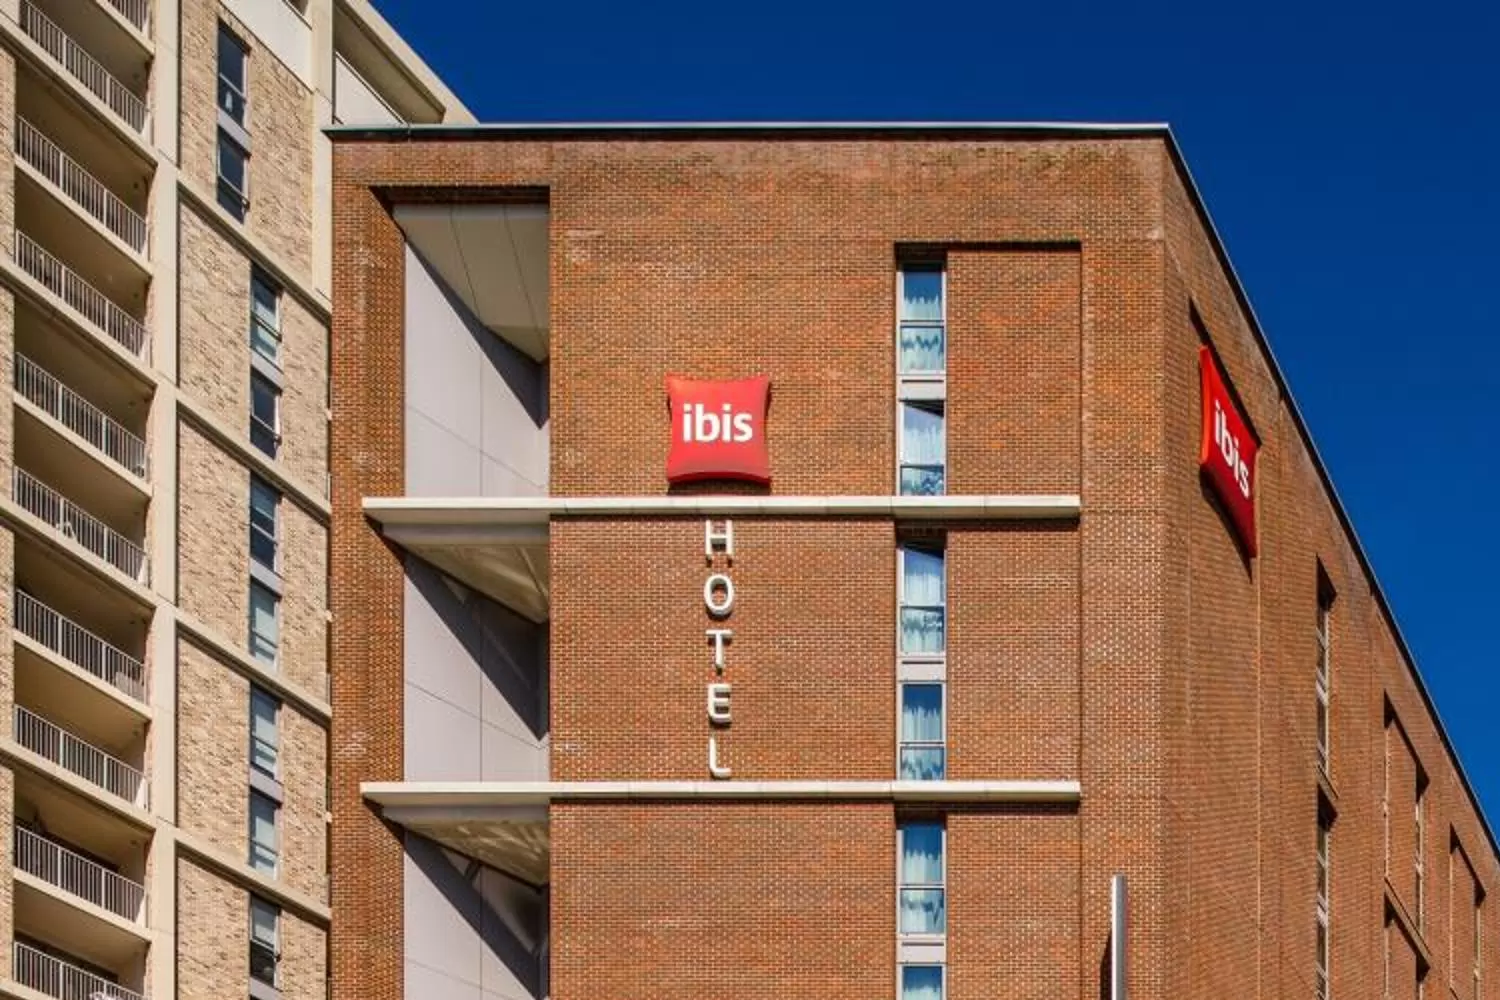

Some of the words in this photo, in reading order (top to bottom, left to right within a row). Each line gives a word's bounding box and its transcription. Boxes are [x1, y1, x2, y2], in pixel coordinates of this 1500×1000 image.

[683, 403, 754, 443] ibis
[1214, 399, 1251, 499] ibis
[704, 520, 735, 779] HOTEL
